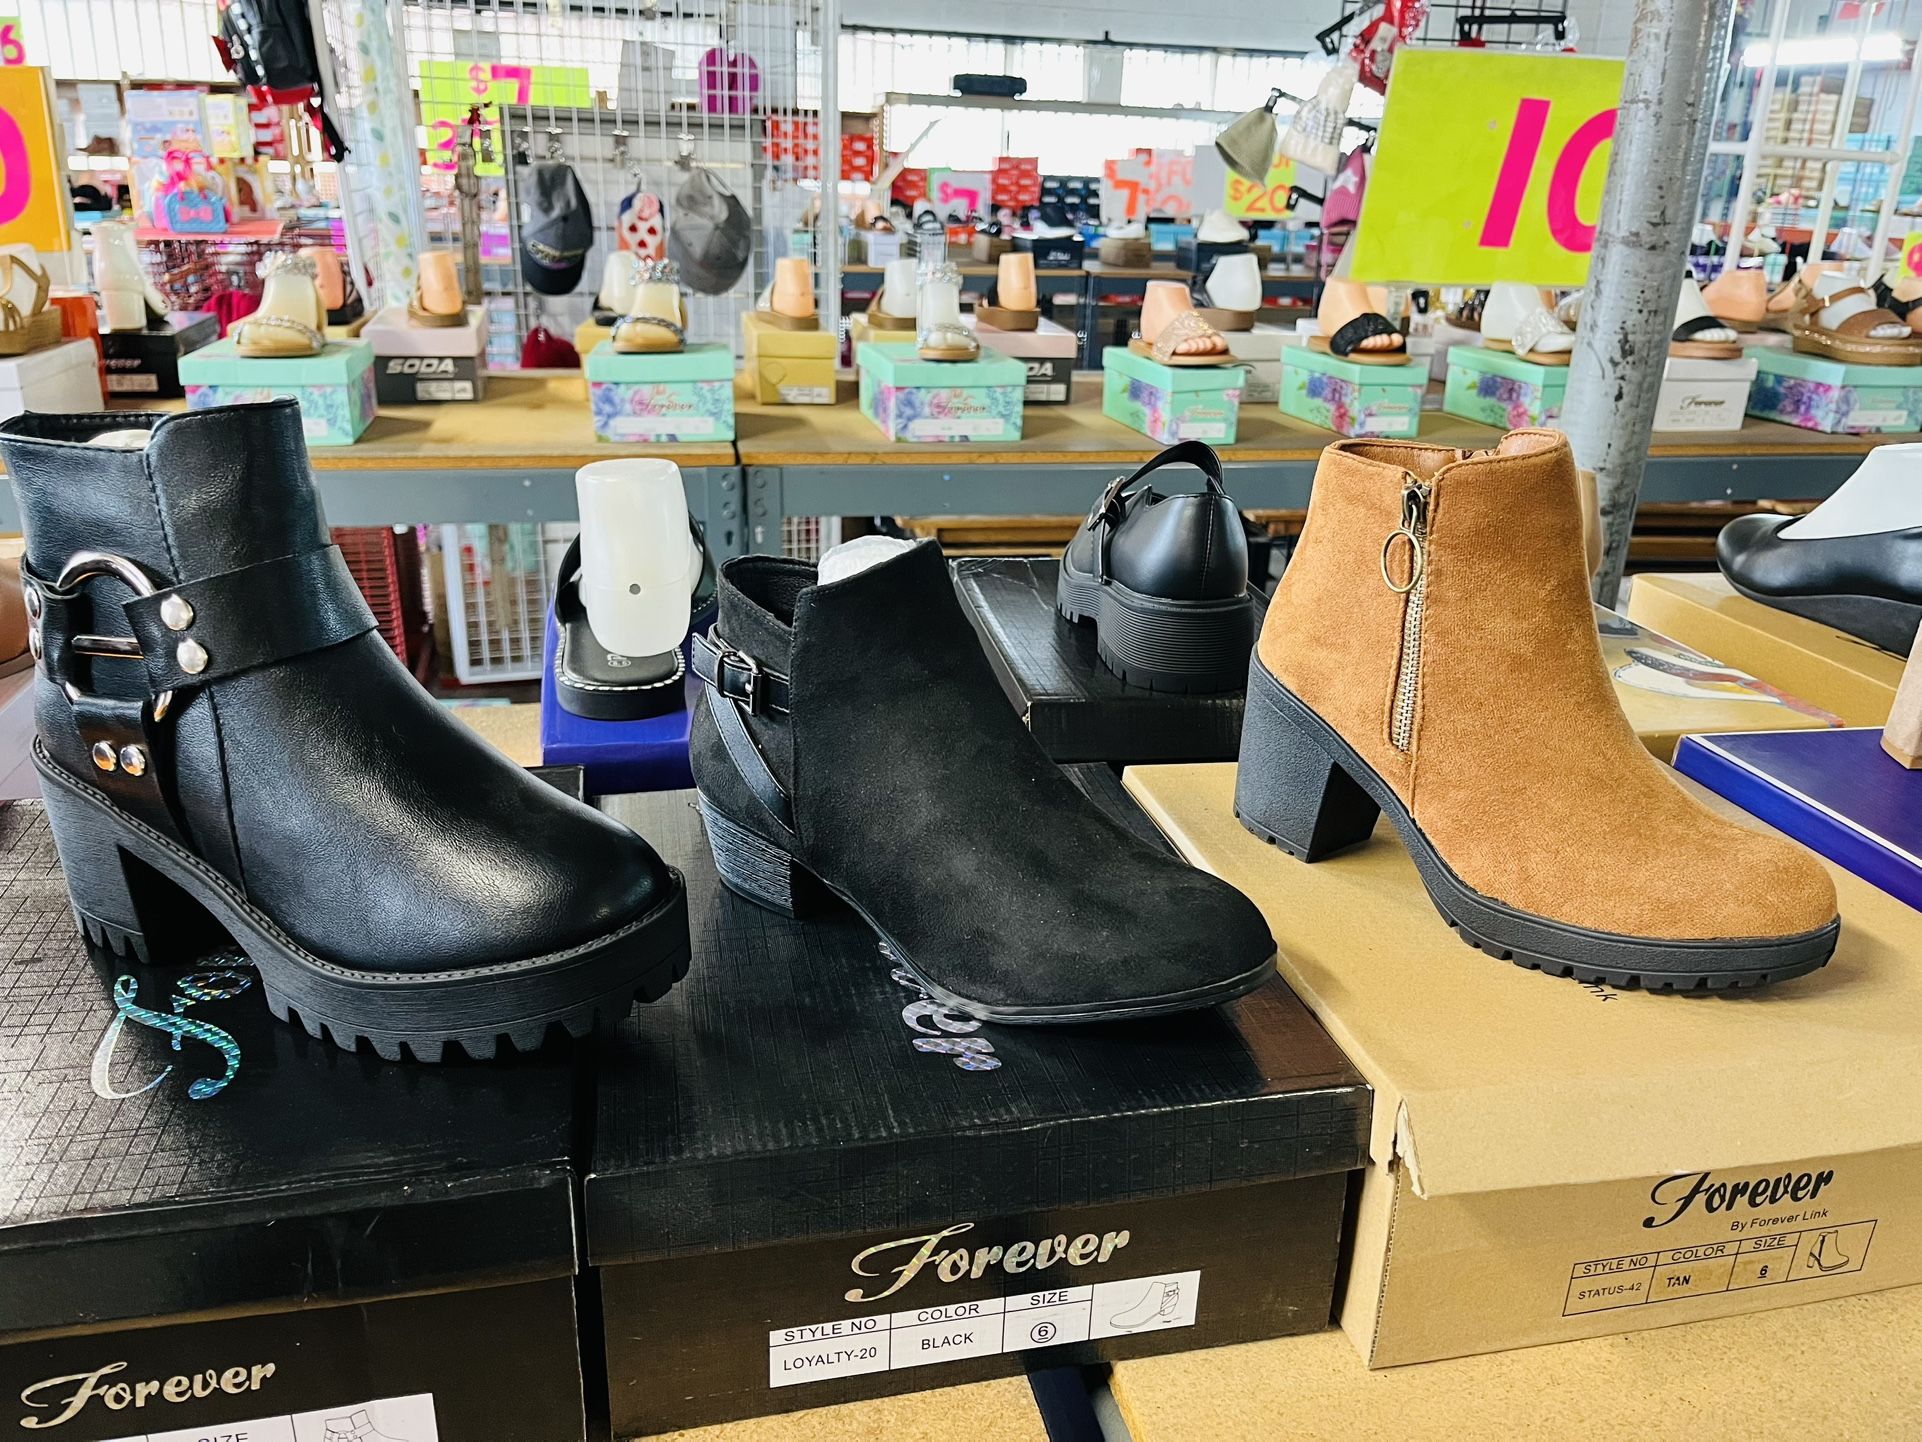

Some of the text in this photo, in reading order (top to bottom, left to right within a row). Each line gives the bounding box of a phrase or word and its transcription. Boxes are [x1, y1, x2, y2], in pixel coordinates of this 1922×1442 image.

[468, 64, 532, 105] $7
[1478, 97, 1618, 254] 10
[938, 181, 980, 212] $7
[1230, 178, 1291, 214] $20
[386, 357, 455, 374] SODA
[1026, 362, 1054, 376] DA
[1642, 1169, 1834, 1229] Forever
[1730, 1208, 1829, 1232] By Forever Link
[844, 1222, 1131, 1303] Forever
[1582, 1236, 1787, 1275] STYLE NO COLOR SIZE
[1577, 1265, 1769, 1300] STATUS-42 TAN 6
[784, 1290, 1069, 1343] STYLE NO COLOR SIZE
[783, 1325, 1050, 1371] LOYALTY-20 BLACK 6
[20, 1361, 276, 1429] Forever
